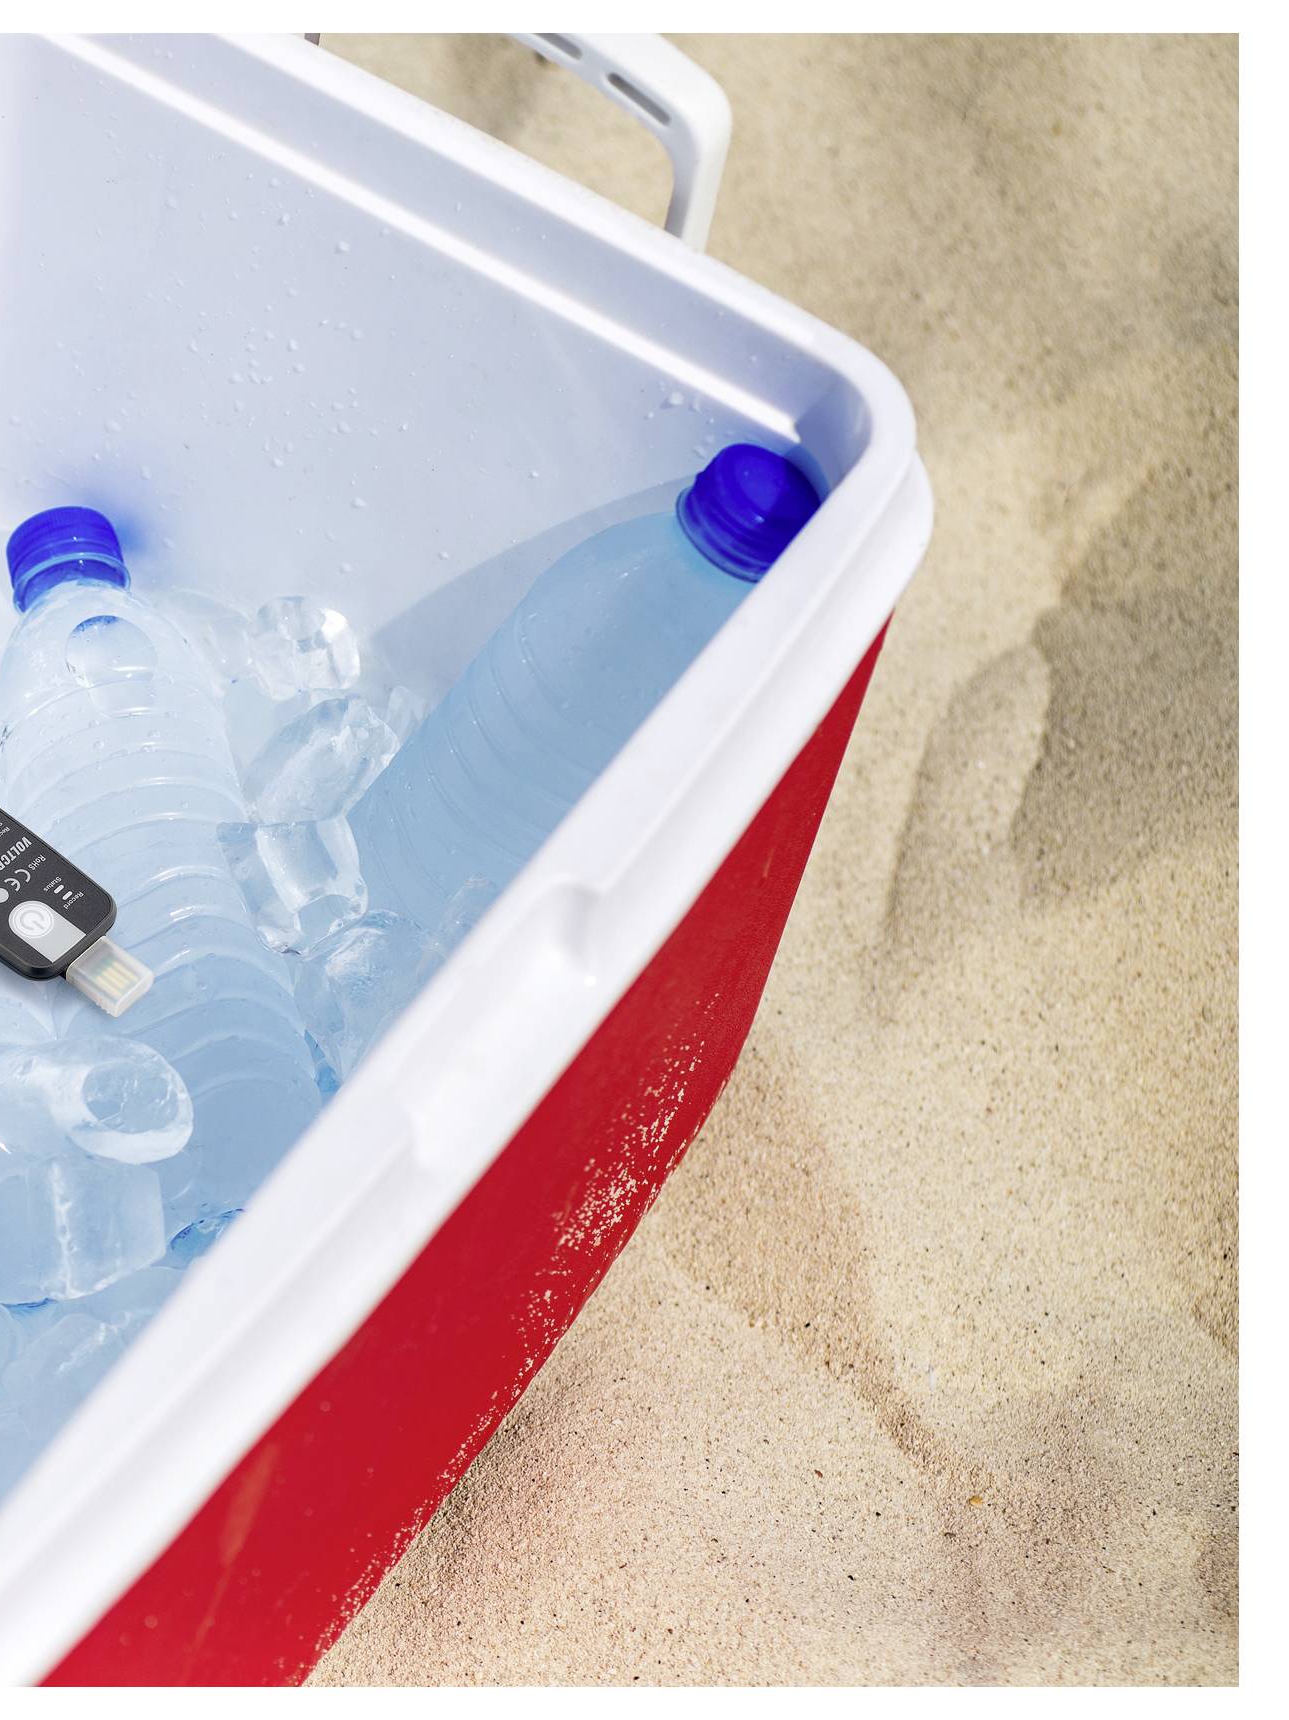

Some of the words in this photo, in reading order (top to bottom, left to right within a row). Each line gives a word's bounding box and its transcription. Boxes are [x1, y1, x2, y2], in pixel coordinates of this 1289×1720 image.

[28, 854, 46, 870] RoHS
[43, 876, 62, 892] Status
[63, 891, 84, 910] Record
